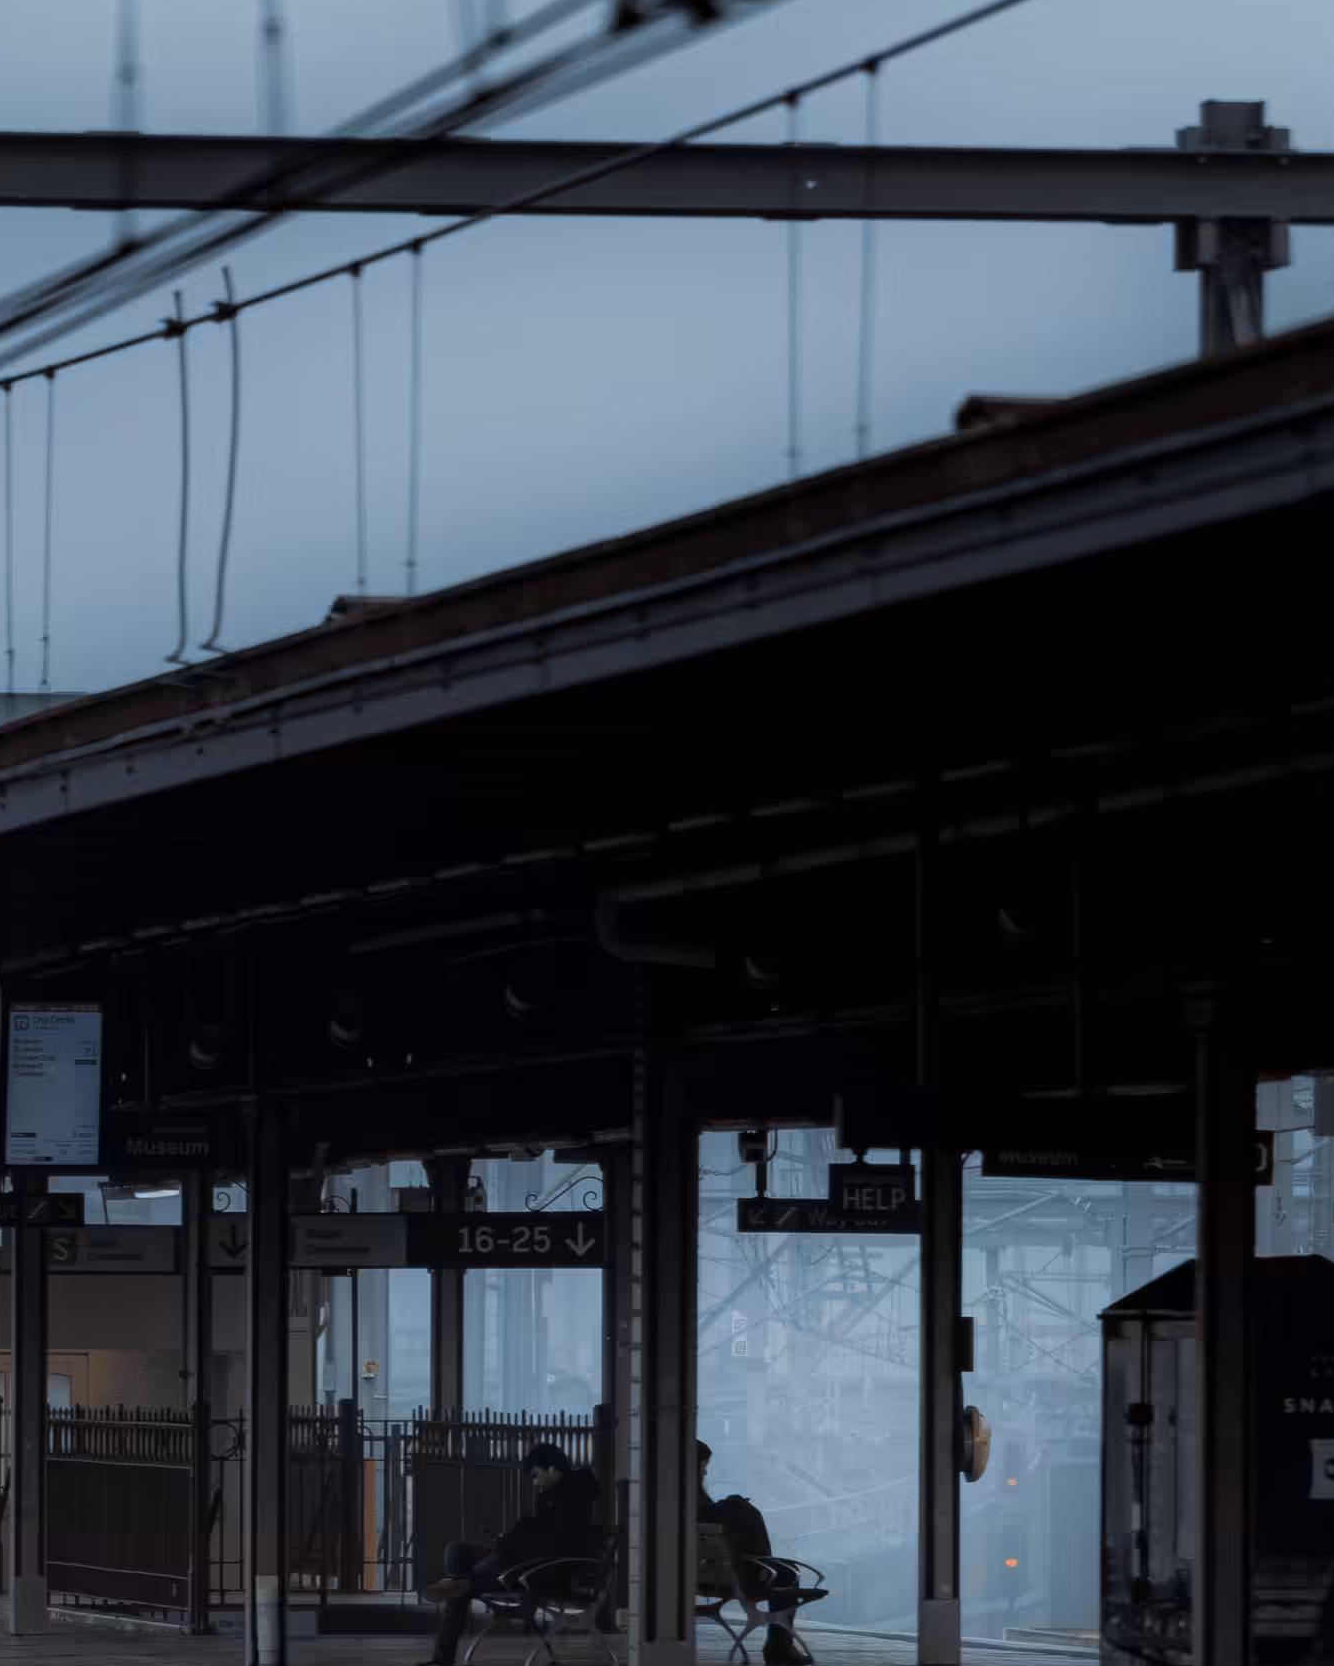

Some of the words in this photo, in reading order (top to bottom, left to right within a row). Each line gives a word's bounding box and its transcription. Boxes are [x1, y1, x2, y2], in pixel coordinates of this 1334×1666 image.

[125, 1136, 211, 1157] Museum
[842, 1186, 908, 1212] HELP
[458, 1225, 552, 1254] 16-25
